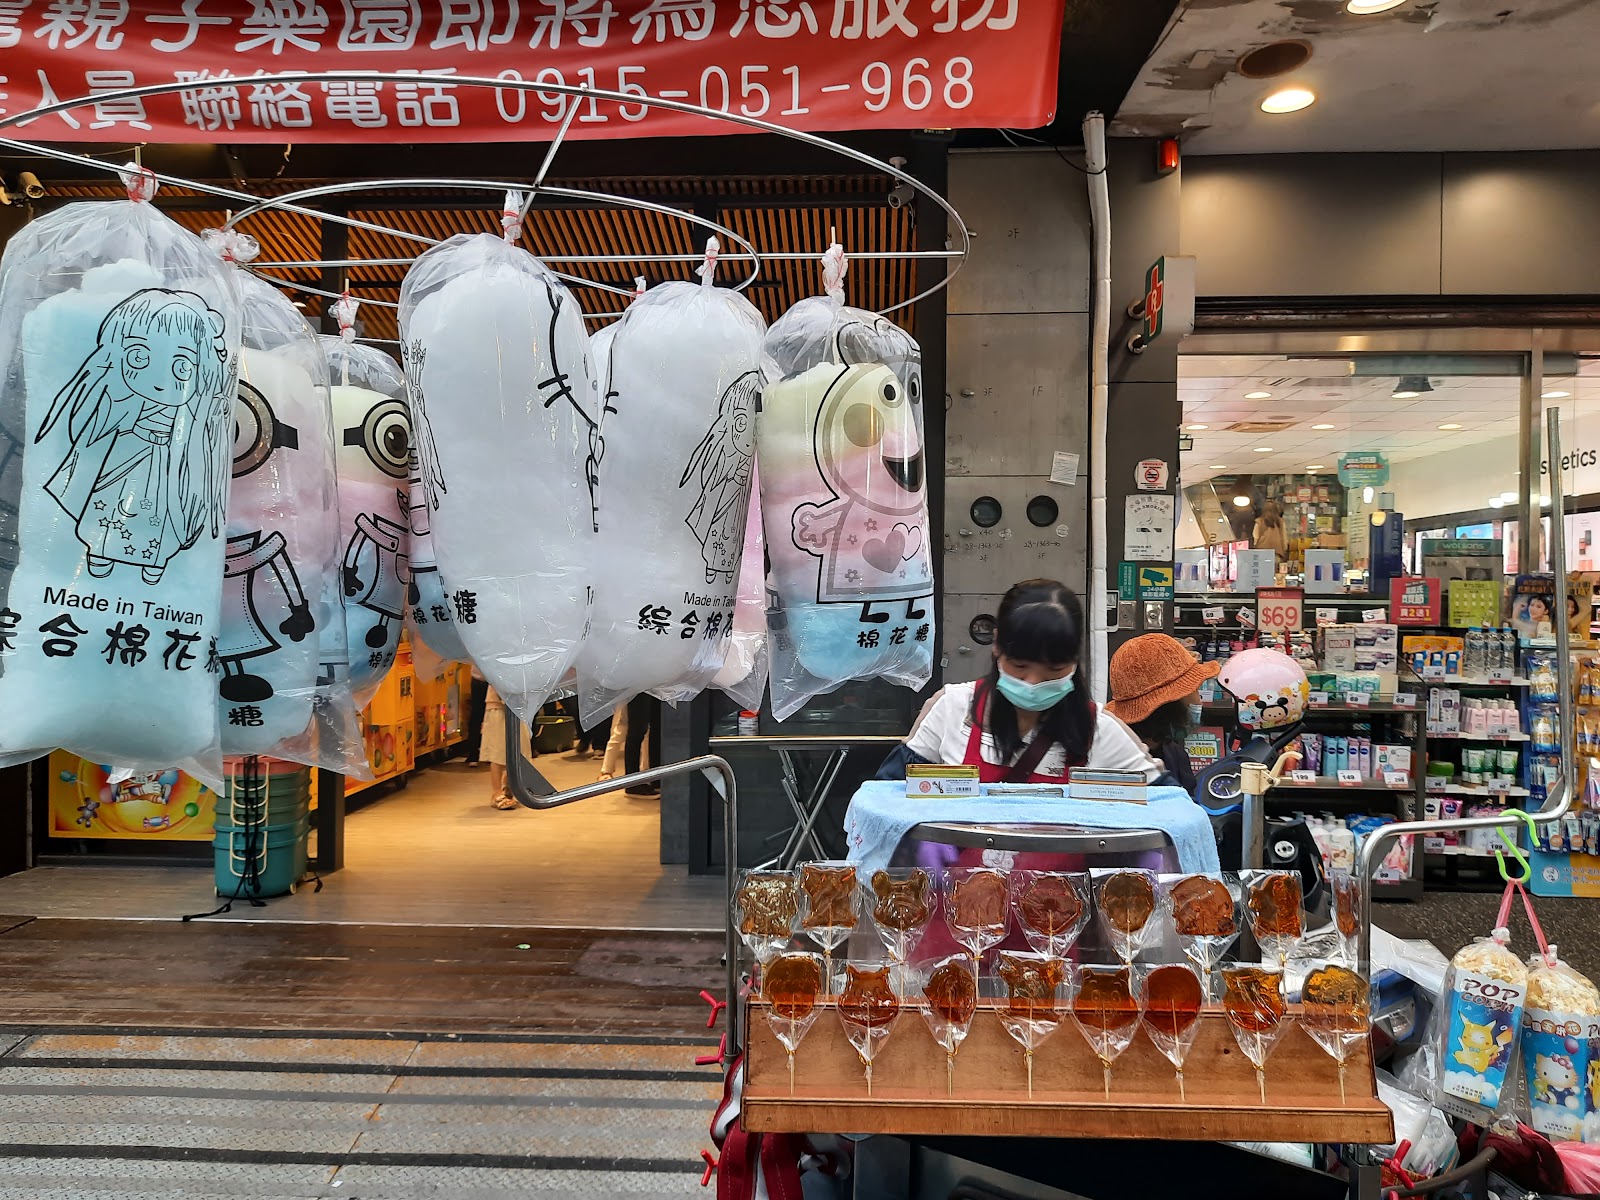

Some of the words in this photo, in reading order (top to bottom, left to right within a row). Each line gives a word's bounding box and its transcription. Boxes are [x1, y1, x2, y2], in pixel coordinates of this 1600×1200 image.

[0, 0, 1017, 55] 親子樂園即將為您服
[0, 70, 151, 131] 人員
[174, 68, 460, 131] 聯絡電話
[495, 57, 974, 123] 0915-051-968
[1540, 448, 1597, 475] setics
[43, 586, 109, 612] Made
[115, 597, 134, 616] in
[142, 600, 203, 626] Taiwan
[453, 589, 477, 625] 糖
[684, 591, 712, 607] Made
[713, 595, 722, 607] in
[412, 605, 450, 625] 棉花
[1261, 605, 1299, 627] $69
[857, 622, 930, 649] 棉花糖
[228, 704, 264, 727] 糖
[1189, 746, 1215, 756] $800
[1463, 978, 1520, 1001] POP
